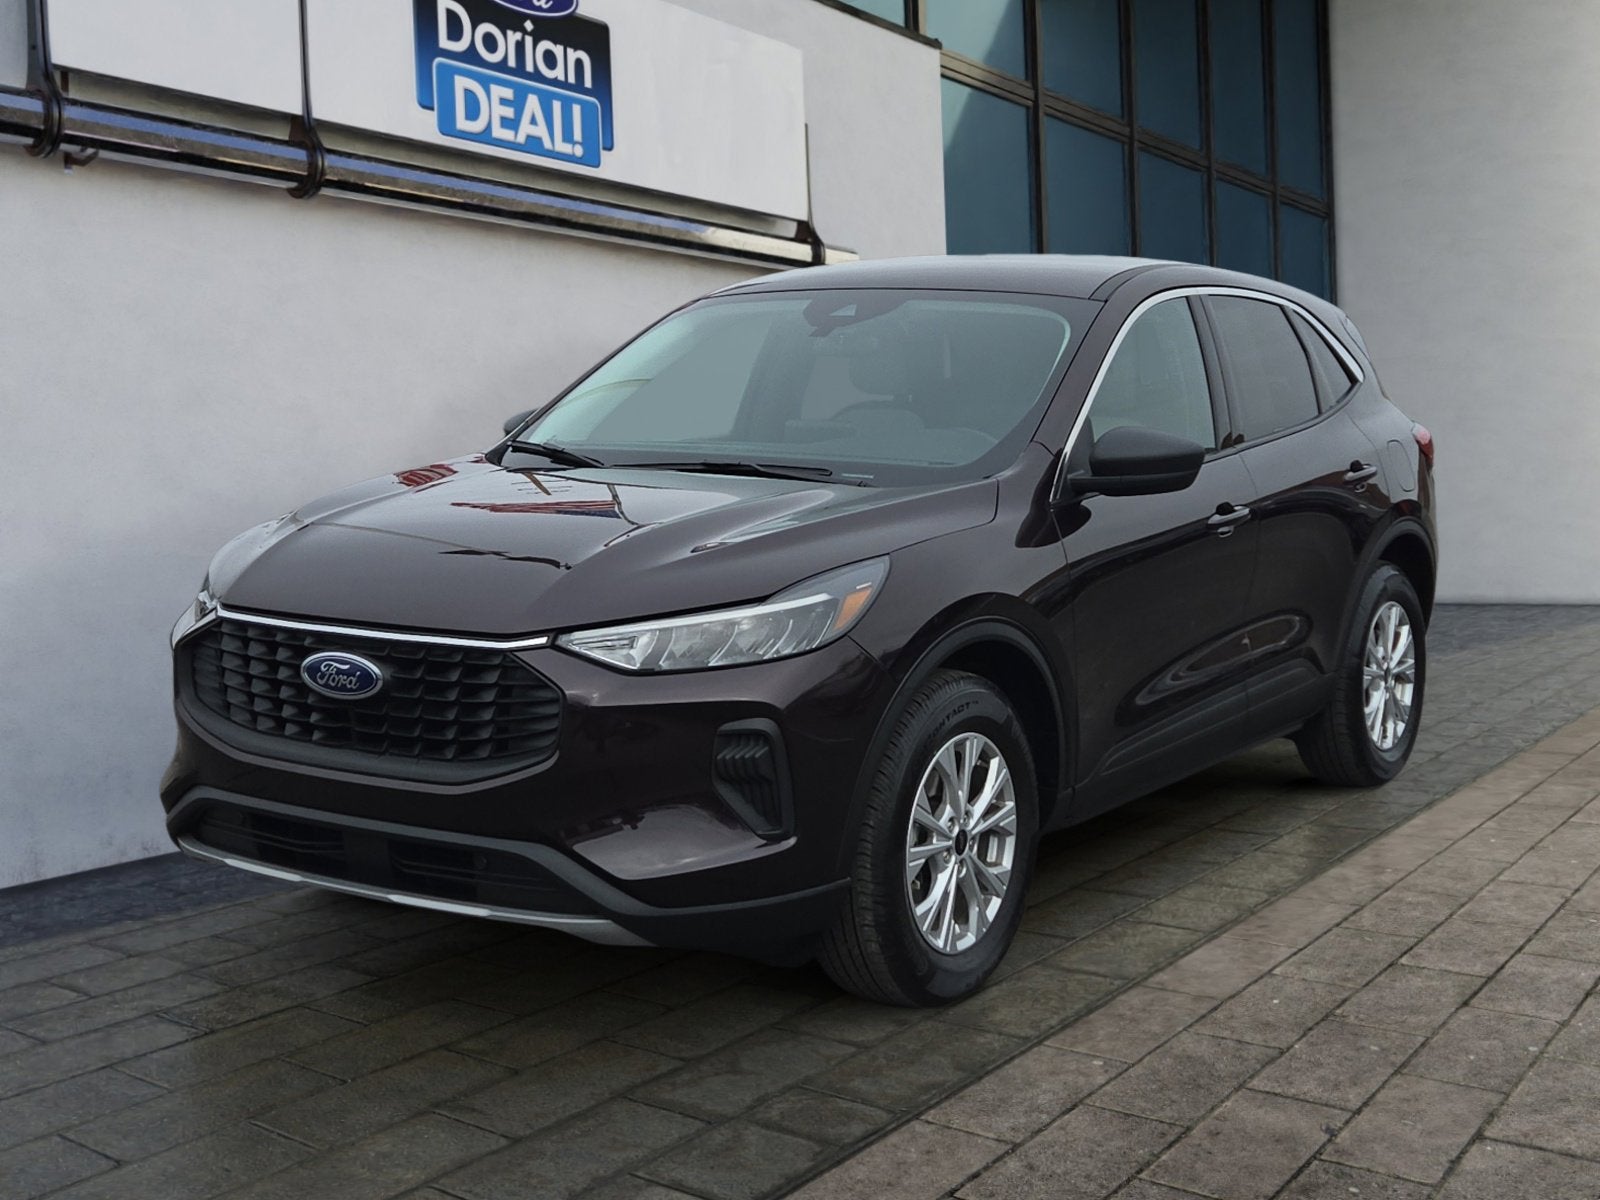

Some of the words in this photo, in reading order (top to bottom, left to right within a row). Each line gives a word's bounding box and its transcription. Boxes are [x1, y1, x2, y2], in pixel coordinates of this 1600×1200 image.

[437, 0, 592, 88] Dorian
[454, 74, 584, 158] DEAL!
[316, 660, 361, 689] Ford
